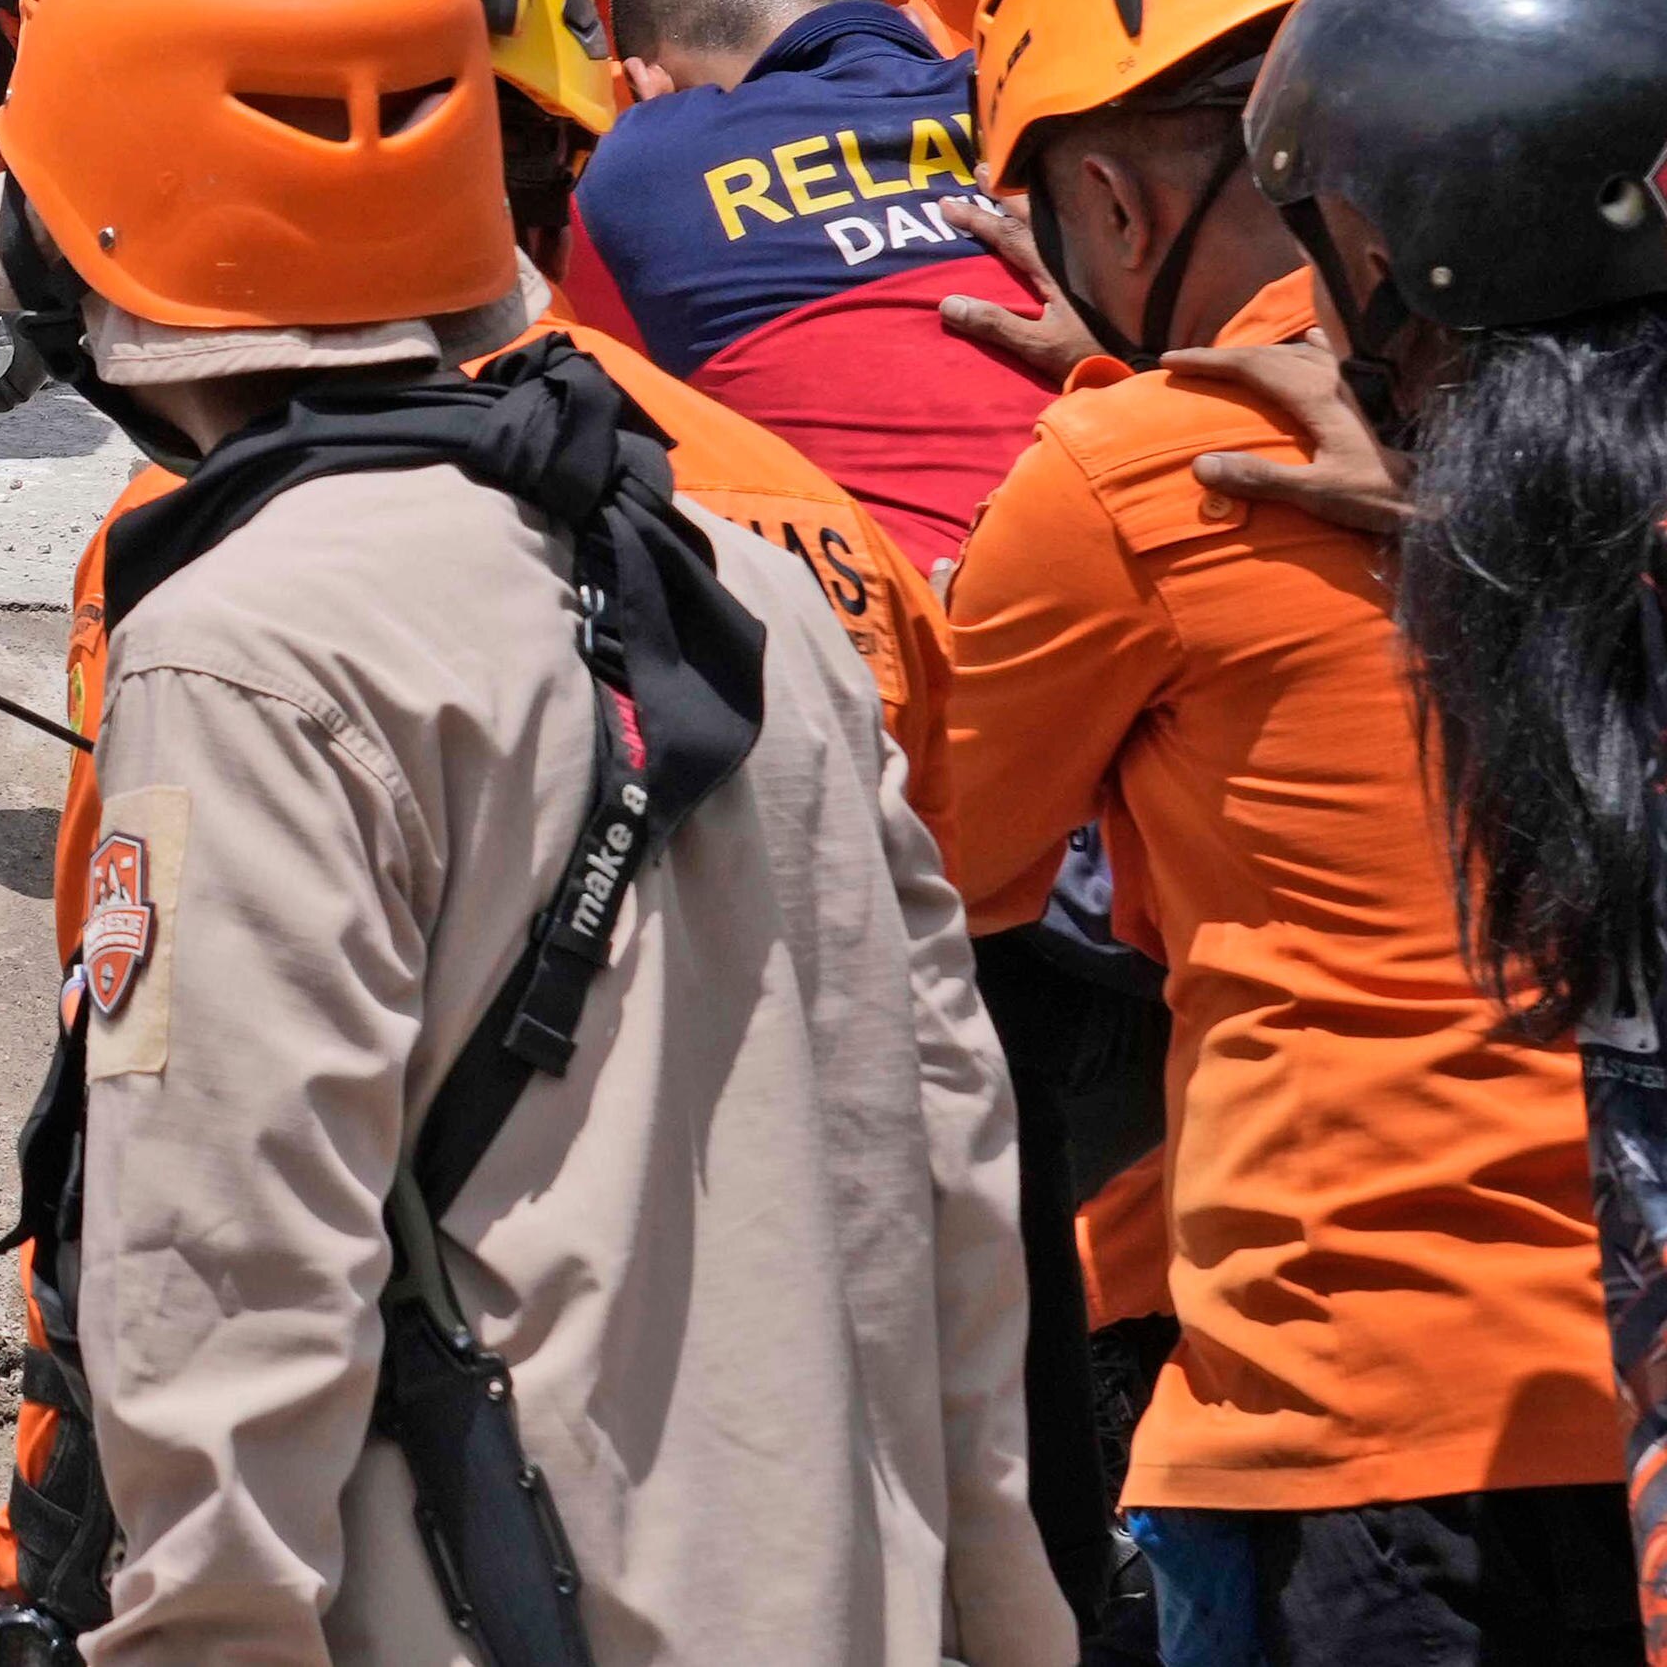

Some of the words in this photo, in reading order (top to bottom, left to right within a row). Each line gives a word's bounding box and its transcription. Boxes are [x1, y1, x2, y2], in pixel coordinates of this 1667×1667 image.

[704, 112, 978, 242] RELA
[571, 822, 634, 939] make
[622, 783, 649, 816] a
